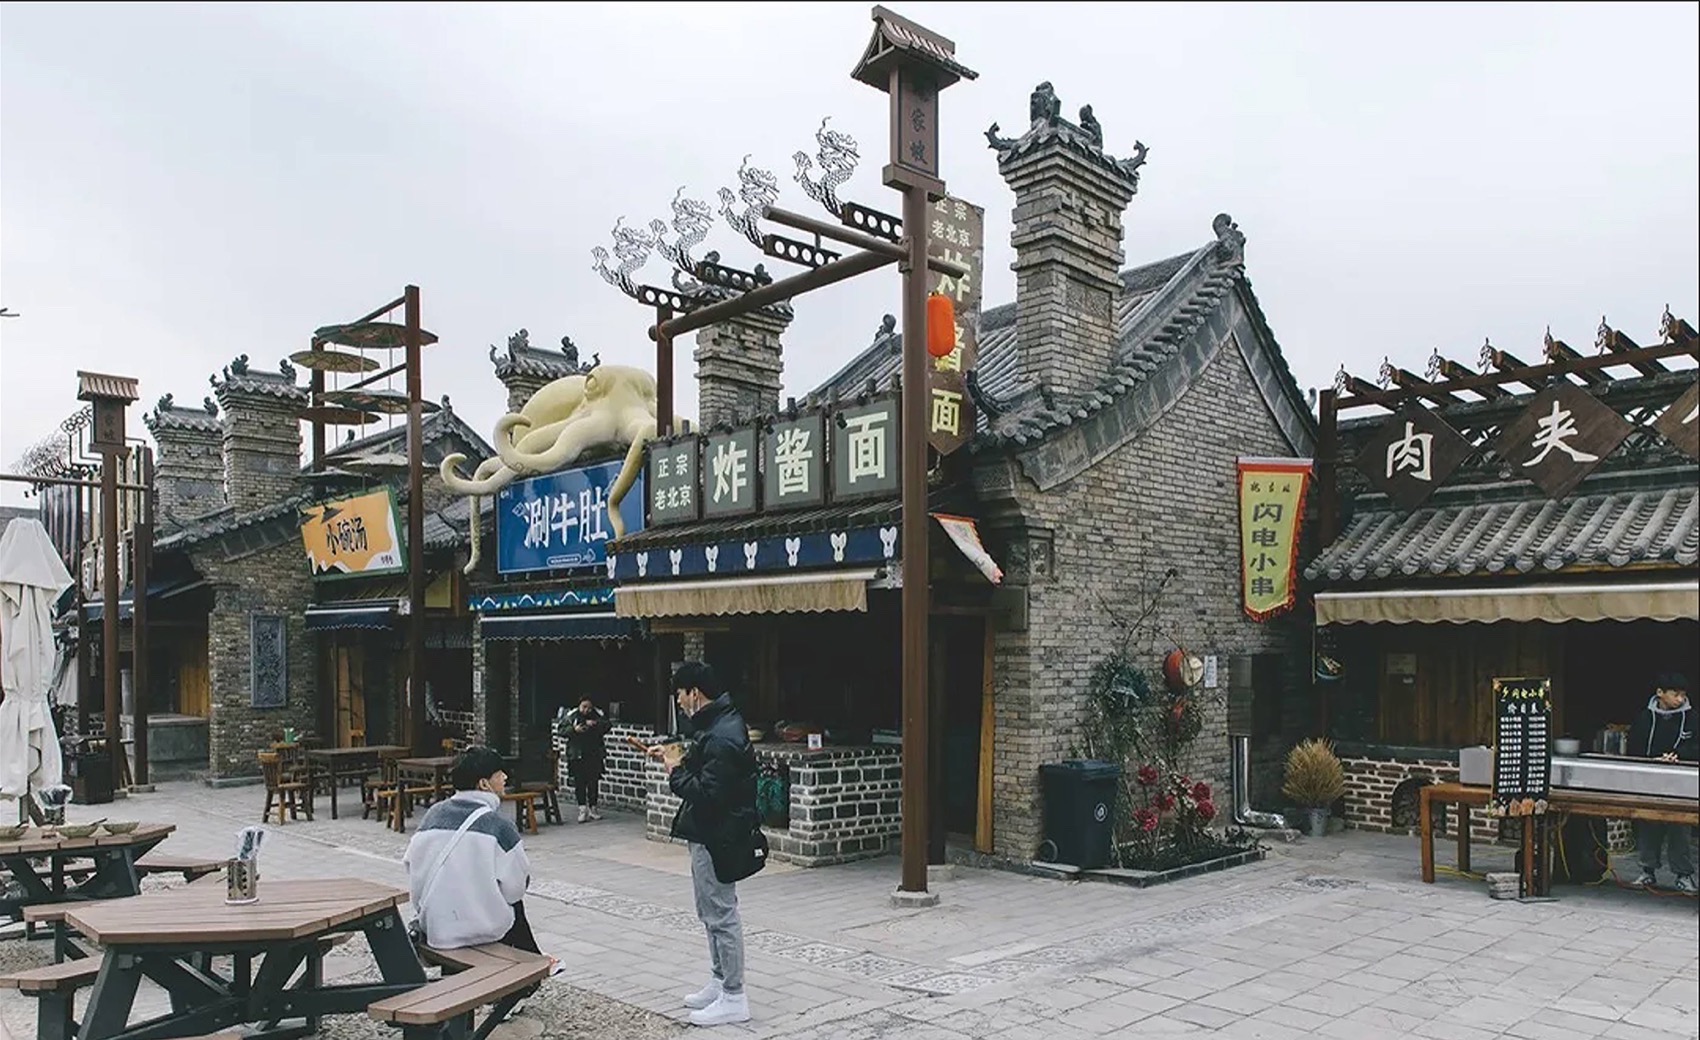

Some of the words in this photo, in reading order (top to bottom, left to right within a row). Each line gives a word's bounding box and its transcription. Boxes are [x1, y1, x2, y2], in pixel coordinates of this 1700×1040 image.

[935, 199, 967, 220] 正宗
[931, 220, 971, 247] 老北京
[712, 411, 889, 503] 炸酱面
[1385, 399, 1698, 481] 肉夹
[657, 456, 688, 477] 正宗
[524, 485, 609, 549] 涮牛肚
[654, 485, 692, 510] 老北京
[326, 516, 368, 555] 小碗汤
[1250, 502, 1284, 597] 闪电小串
